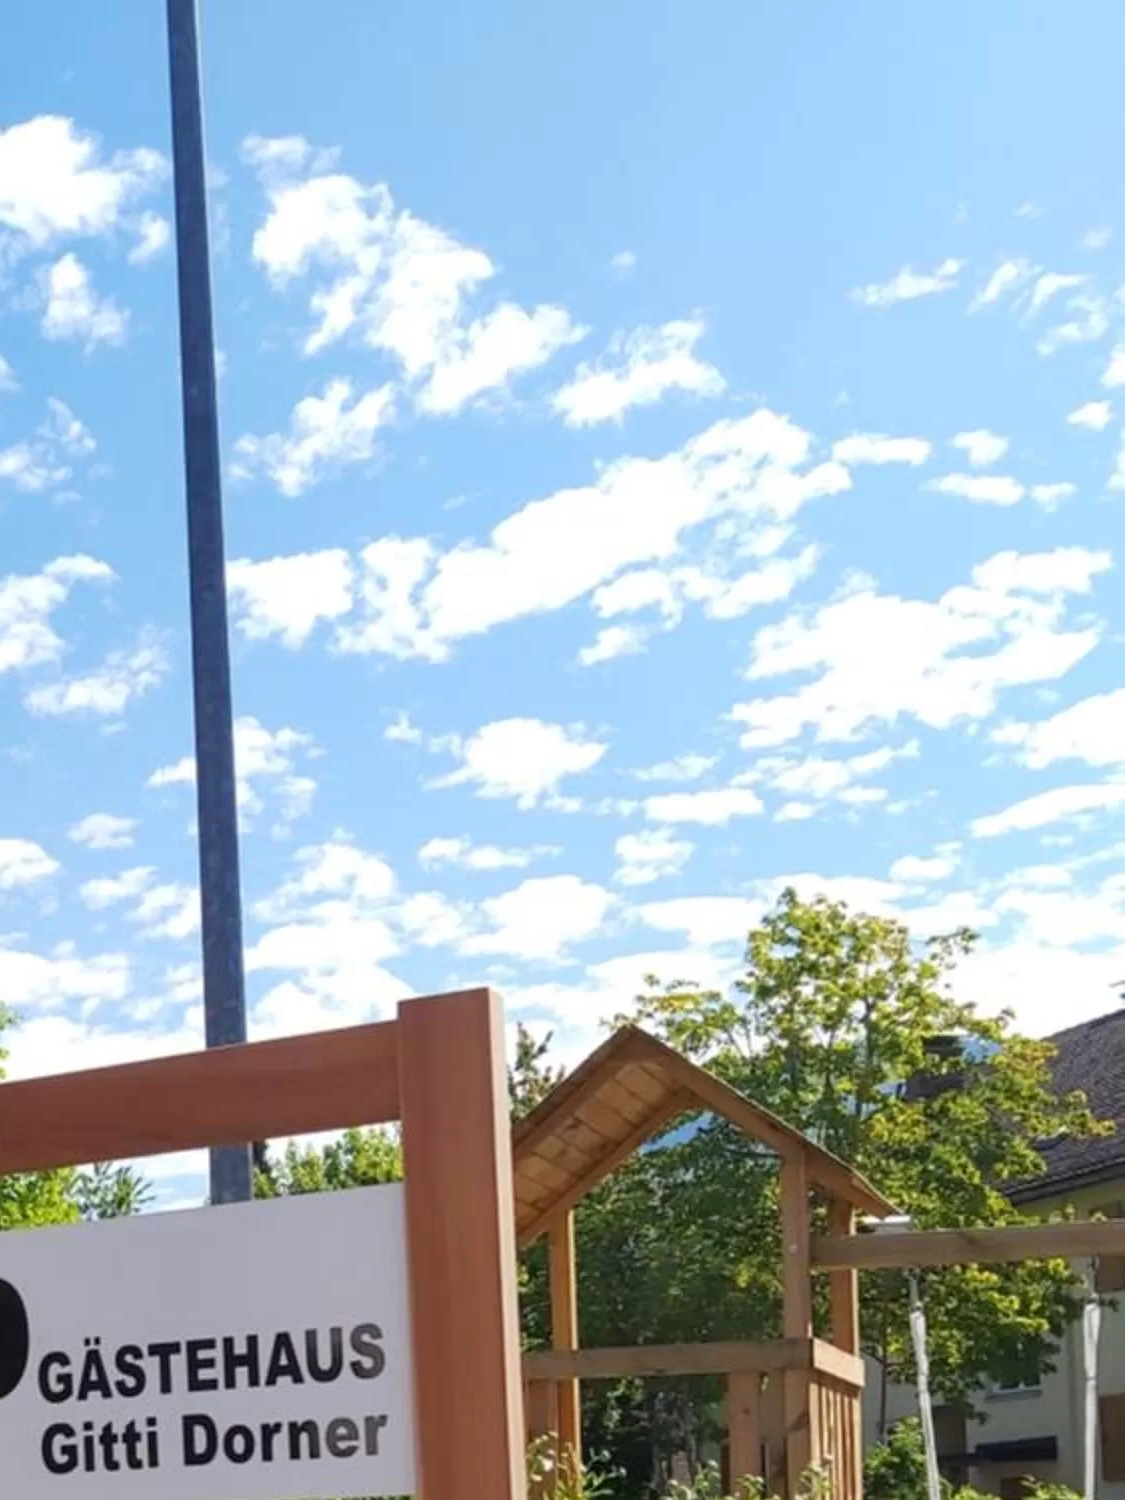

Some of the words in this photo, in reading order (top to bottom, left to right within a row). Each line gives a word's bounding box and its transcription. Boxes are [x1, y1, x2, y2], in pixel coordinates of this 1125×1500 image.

[37, 1322, 386, 1404] GÄSTEHAUS
[41, 1416, 160, 1475] Gitti
[181, 1412, 389, 1467] Dorner
